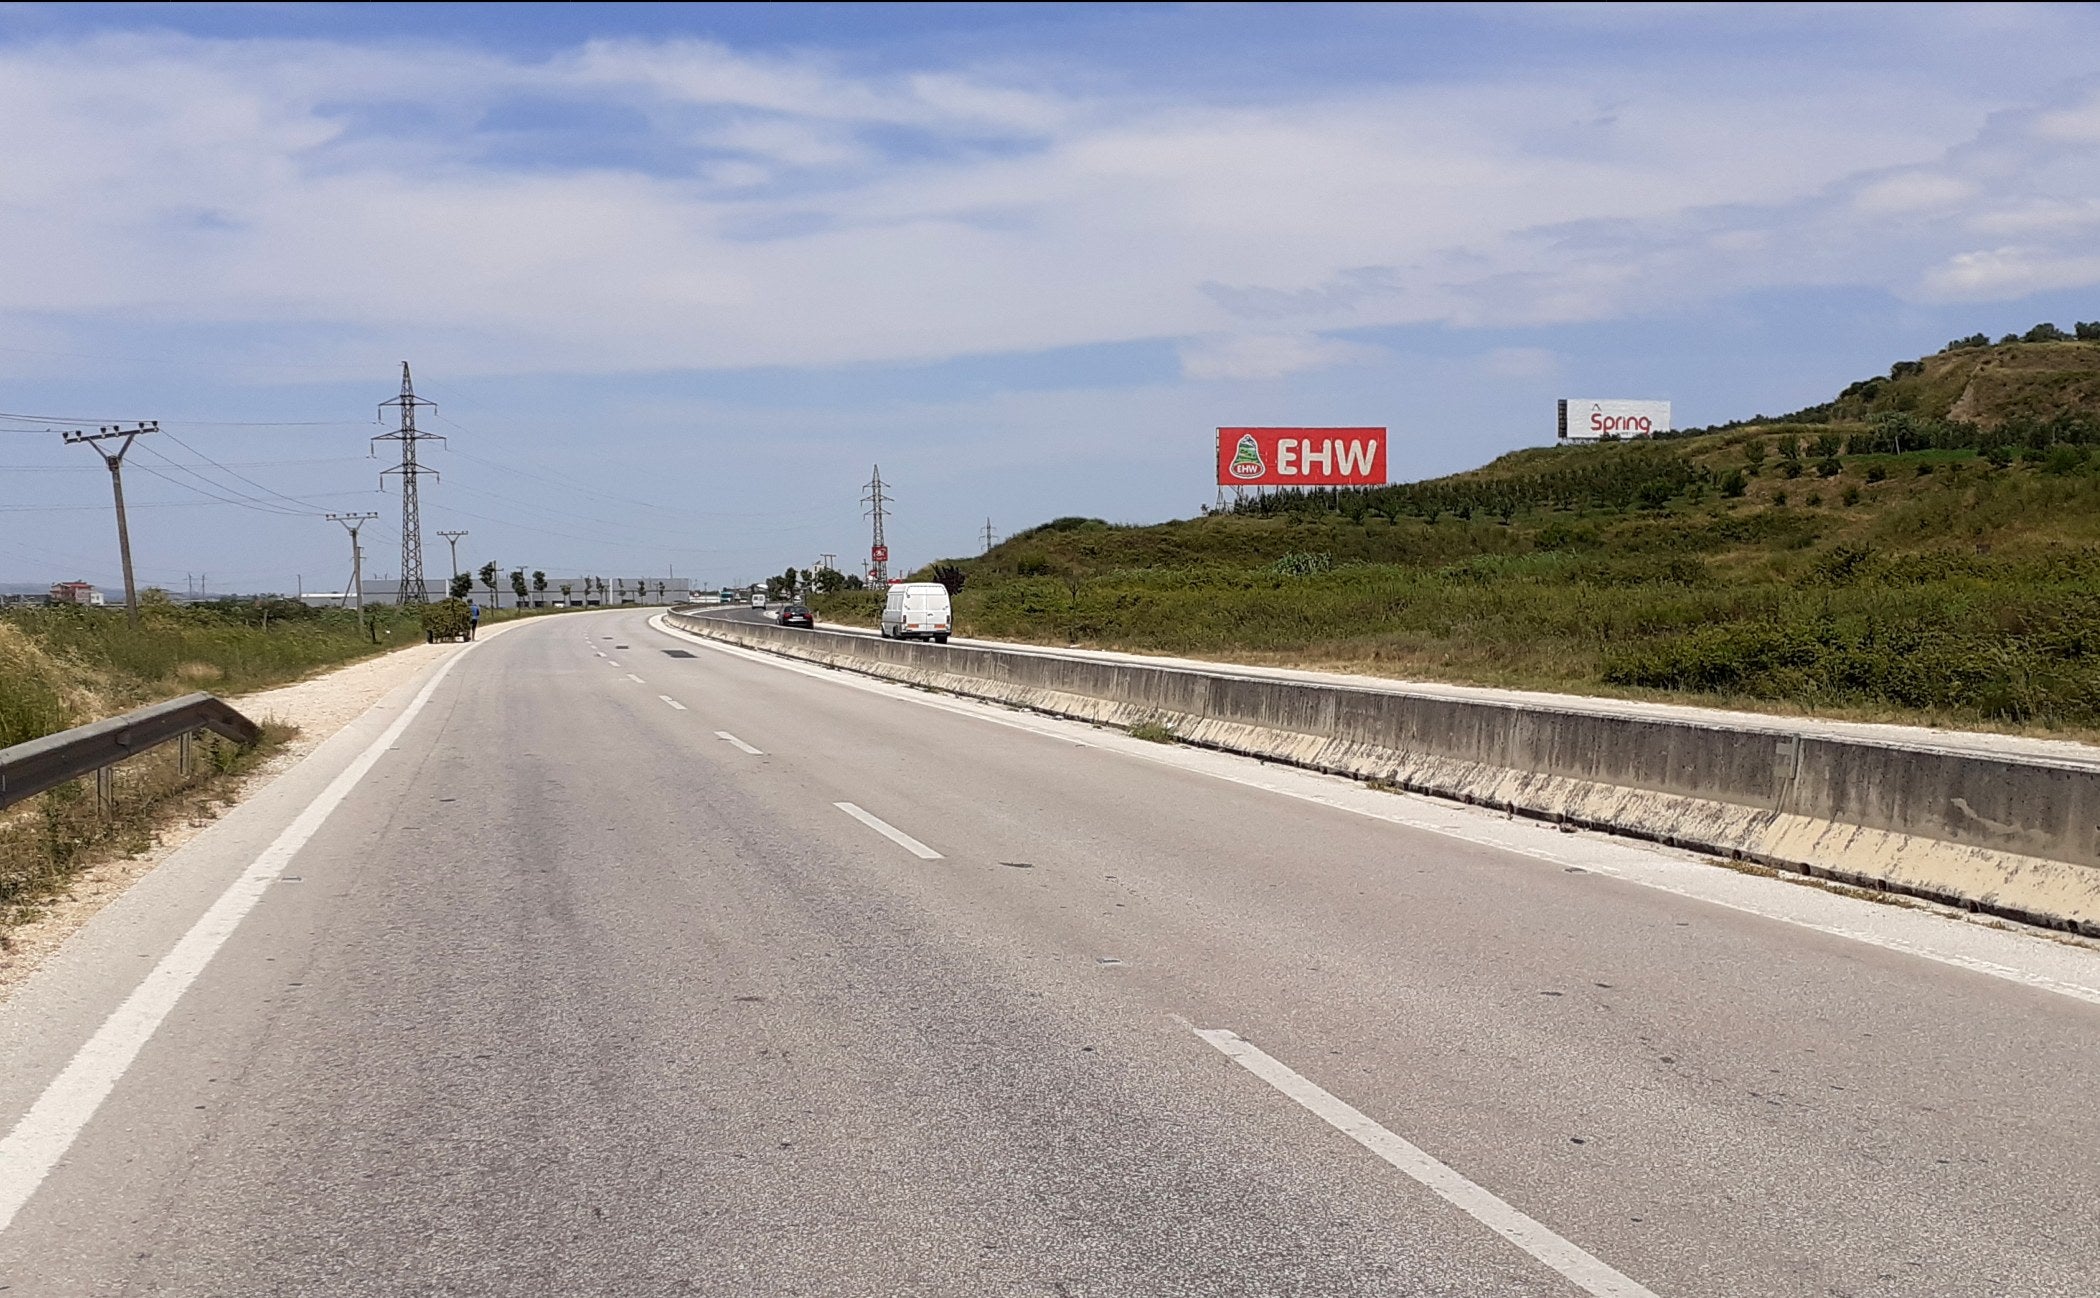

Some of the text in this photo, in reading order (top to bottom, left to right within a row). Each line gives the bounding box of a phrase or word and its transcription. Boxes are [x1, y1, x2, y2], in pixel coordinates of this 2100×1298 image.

[1590, 413, 1651, 436] Spring
[1277, 438, 1377, 476] EHW
[1236, 464, 1258, 474] EHW
